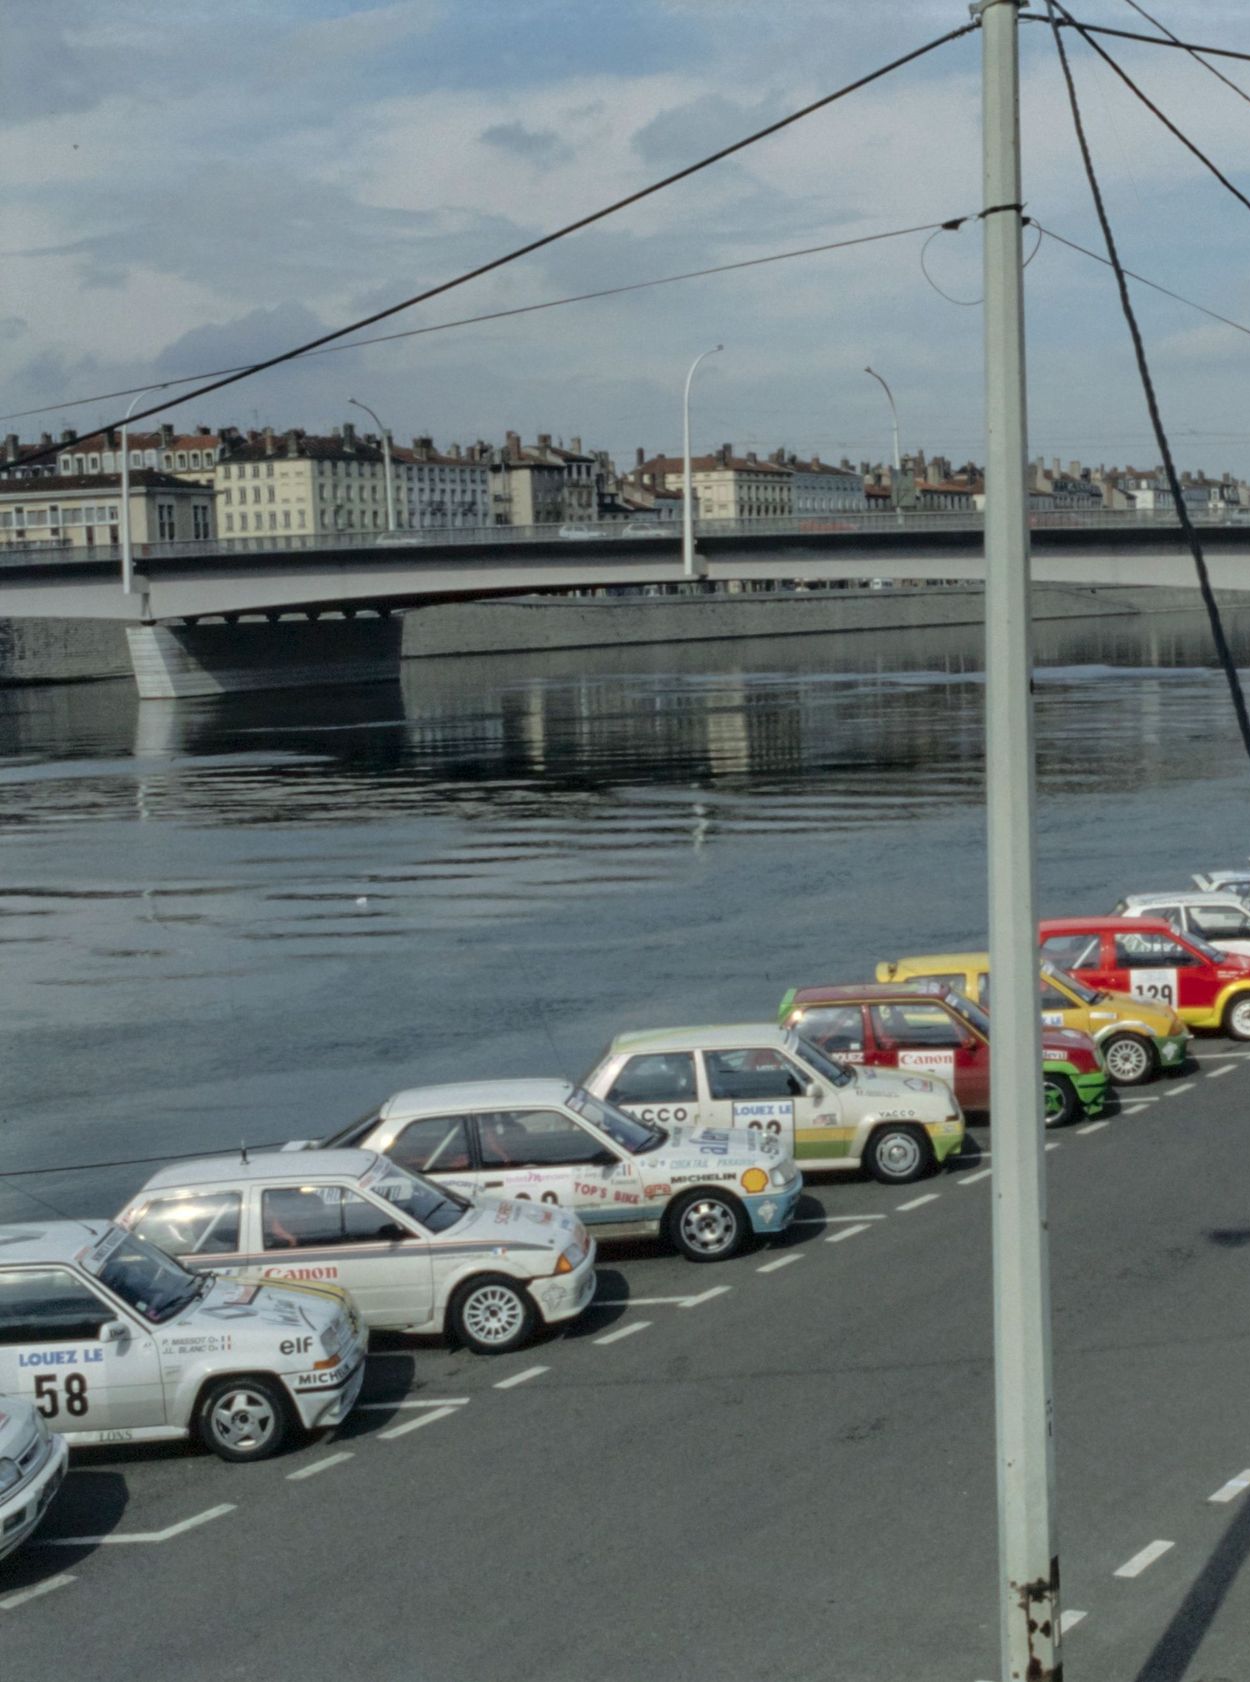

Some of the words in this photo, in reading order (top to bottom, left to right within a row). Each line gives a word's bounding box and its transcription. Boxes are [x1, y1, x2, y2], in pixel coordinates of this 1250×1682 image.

[900, 1053, 953, 1065] Canon
[735, 1105, 774, 1116] LOUEZ
[778, 1104, 792, 1114] LE
[878, 1109, 916, 1118] YACCO
[670, 1173, 737, 1184] MICHELIN
[574, 1182, 608, 1199] TOP'S
[264, 1266, 338, 1280] Canon
[178, 1345, 207, 1354] BLANC
[279, 1336, 313, 1355] elf
[19, 1350, 78, 1367] LOUEZ
[83, 1348, 104, 1363] LE
[34, 1371, 89, 1419] 58
